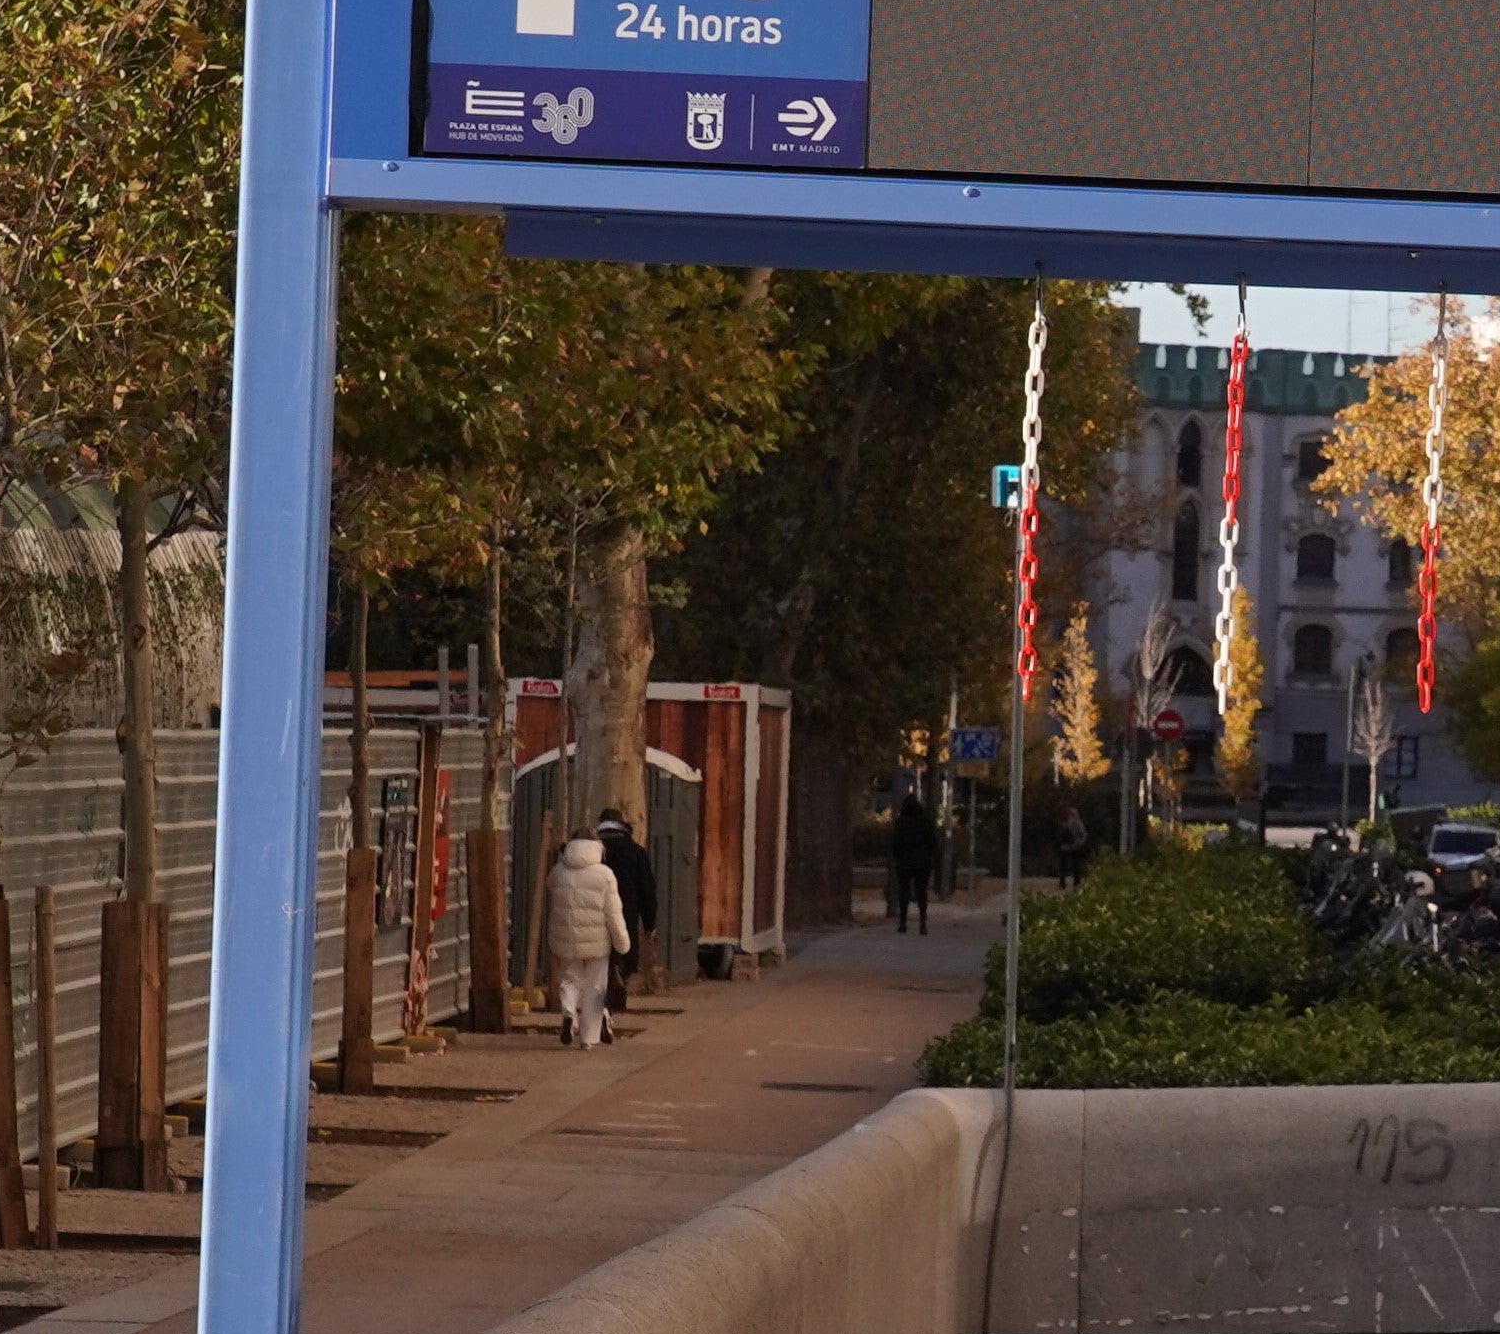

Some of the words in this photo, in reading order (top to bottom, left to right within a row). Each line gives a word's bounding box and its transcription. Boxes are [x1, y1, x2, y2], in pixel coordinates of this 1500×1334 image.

[615, 2, 665, 40] 24
[677, 5, 782, 44] horas
[532, 87, 594, 145] 360
[449, 122, 476, 131] PLAZA
[478, 122, 489, 131] DE
[491, 122, 524, 133] ESPAÑA
[449, 132, 467, 141] HUB
[468, 133, 478, 141] DE
[480, 133, 524, 143] MOVILIDAD
[772, 143, 795, 152] EMT
[800, 144, 840, 154] MADRID
